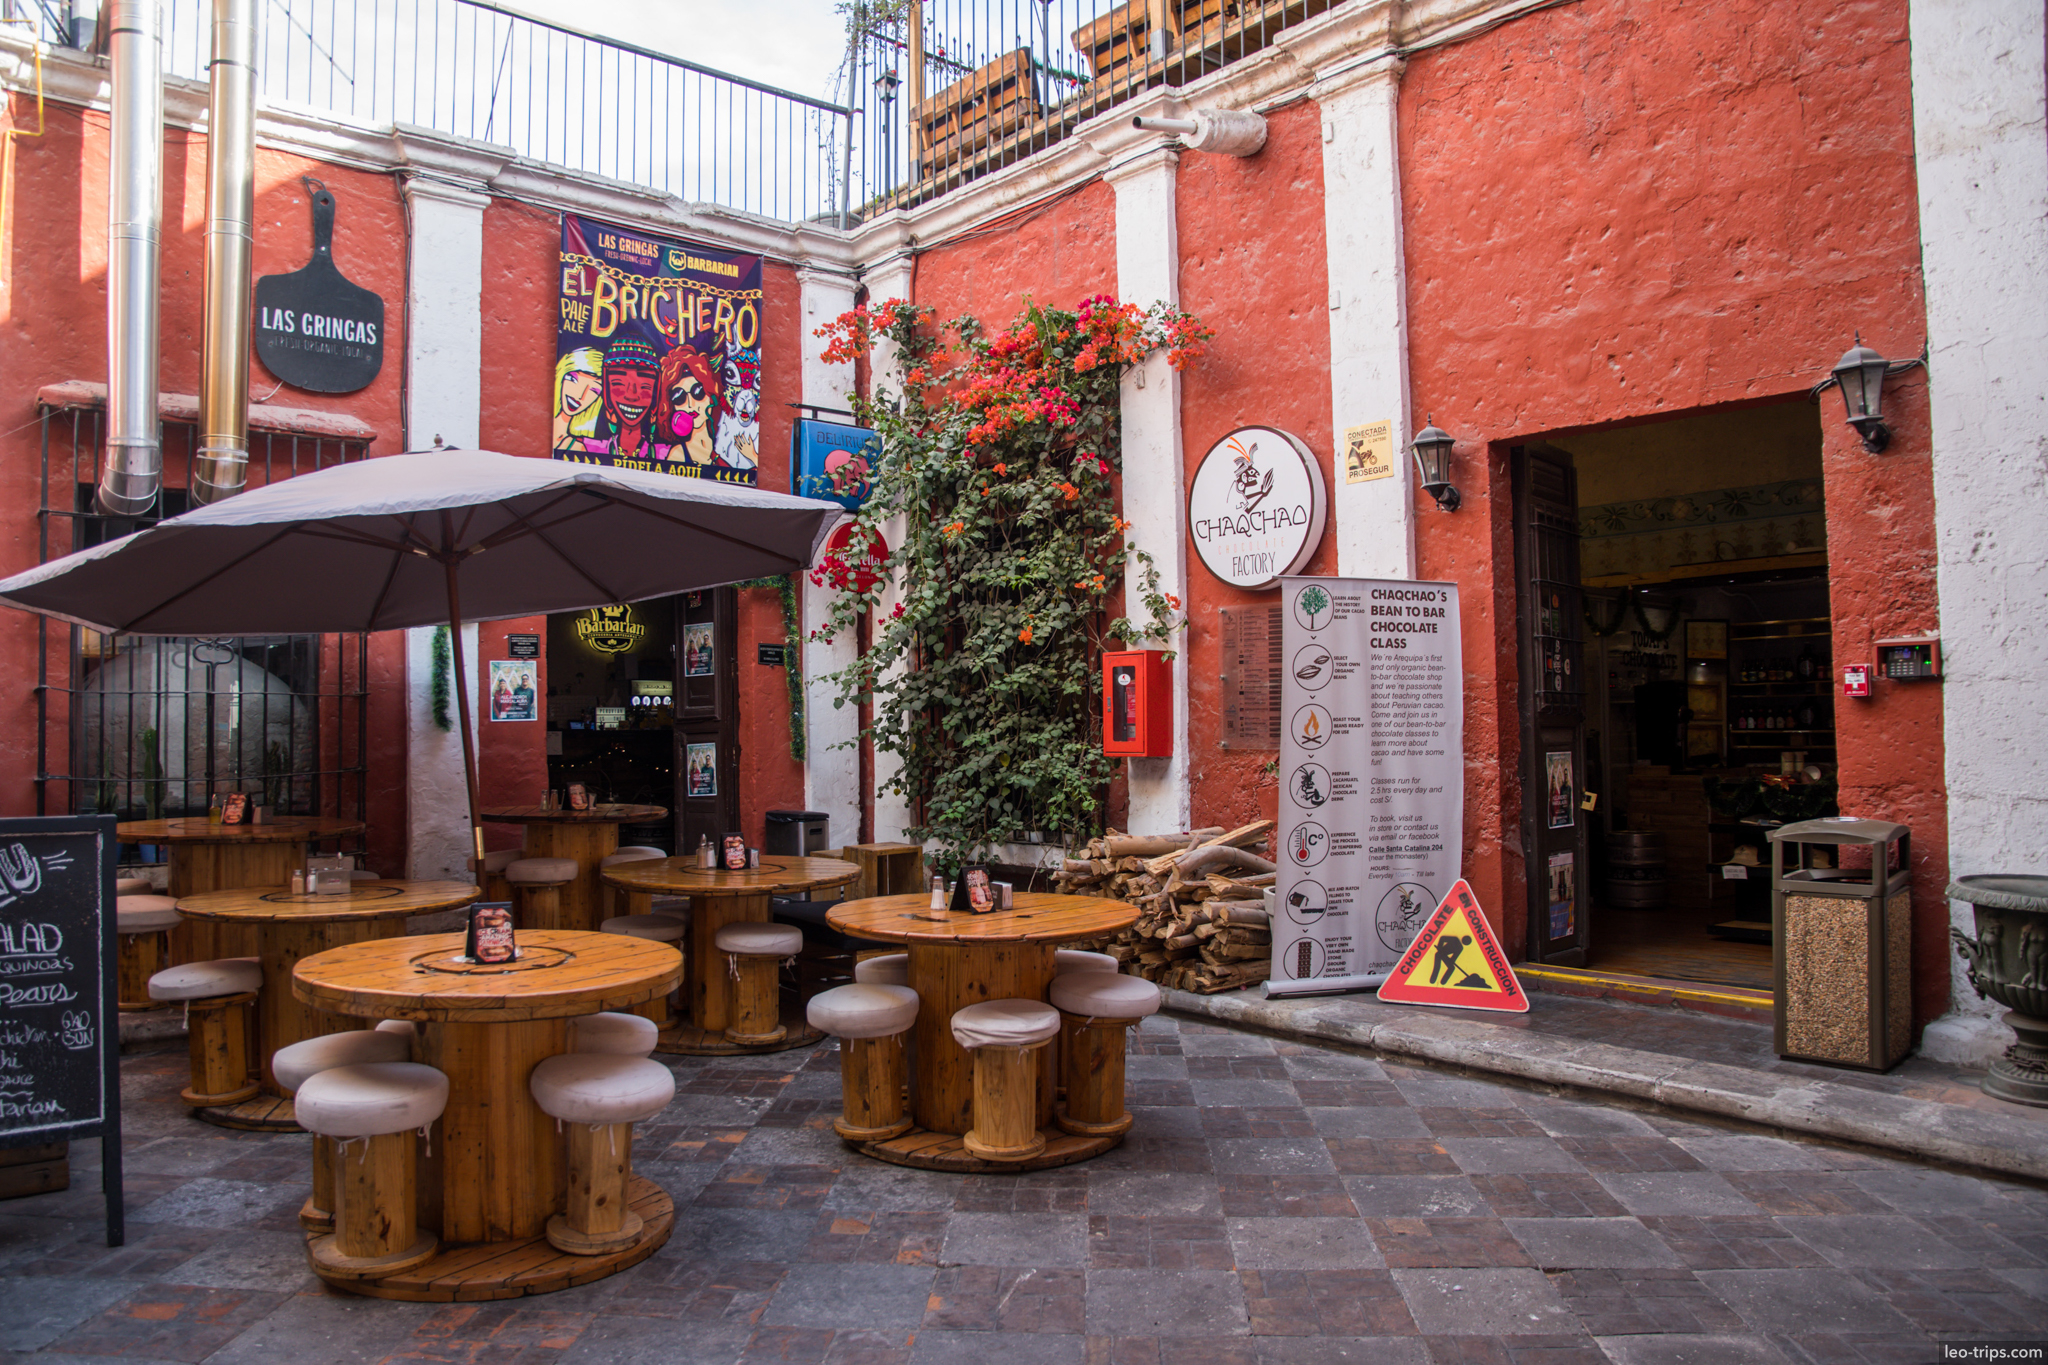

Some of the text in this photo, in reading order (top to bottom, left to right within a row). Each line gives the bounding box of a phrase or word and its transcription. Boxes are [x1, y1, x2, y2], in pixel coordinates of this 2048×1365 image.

[598, 233, 659, 258] LAS GRINGAS
[687, 256, 739, 278] BARBARIAN
[562, 265, 593, 297] EL
[561, 298, 592, 324] PALE
[591, 274, 759, 348] BRICHERO
[262, 306, 377, 345] LAS GRINGAS
[564, 320, 585, 334] ALE
[816, 431, 867, 450] DELIRIU
[1348, 426, 1386, 440] CONECTADA
[668, 464, 702, 479] AQUÍ
[1349, 465, 1389, 478] PROSEGUR
[1196, 505, 1307, 542] CHAQCHAO
[1218, 537, 1284, 555] CHOCOLATE
[1232, 552, 1276, 577] FACTORY
[1370, 606, 1445, 618] BEAN TO BAR
[576, 617, 645, 636] Barbarian
[1370, 622, 1438, 634] CHOCOLATE
[1370, 638, 1407, 649] CLASS
[1623, 651, 1678, 669] CHOCOLATE
[1386, 664, 1400, 672] only
[1401, 664, 1426, 672] organic
[1427, 674, 1442, 682] shop
[1406, 683, 1442, 691] passionate
[1392, 693, 1420, 701] teaching
[1406, 711, 1419, 719] join
[1415, 786, 1427, 794] day
[1408, 832, 1440, 840] facebook
[1378, 920, 1426, 932] CHAQCHA
[1400, 904, 1453, 975] CHOCOLATE
[1458, 892, 1517, 997] EN CONSTRUCCION
